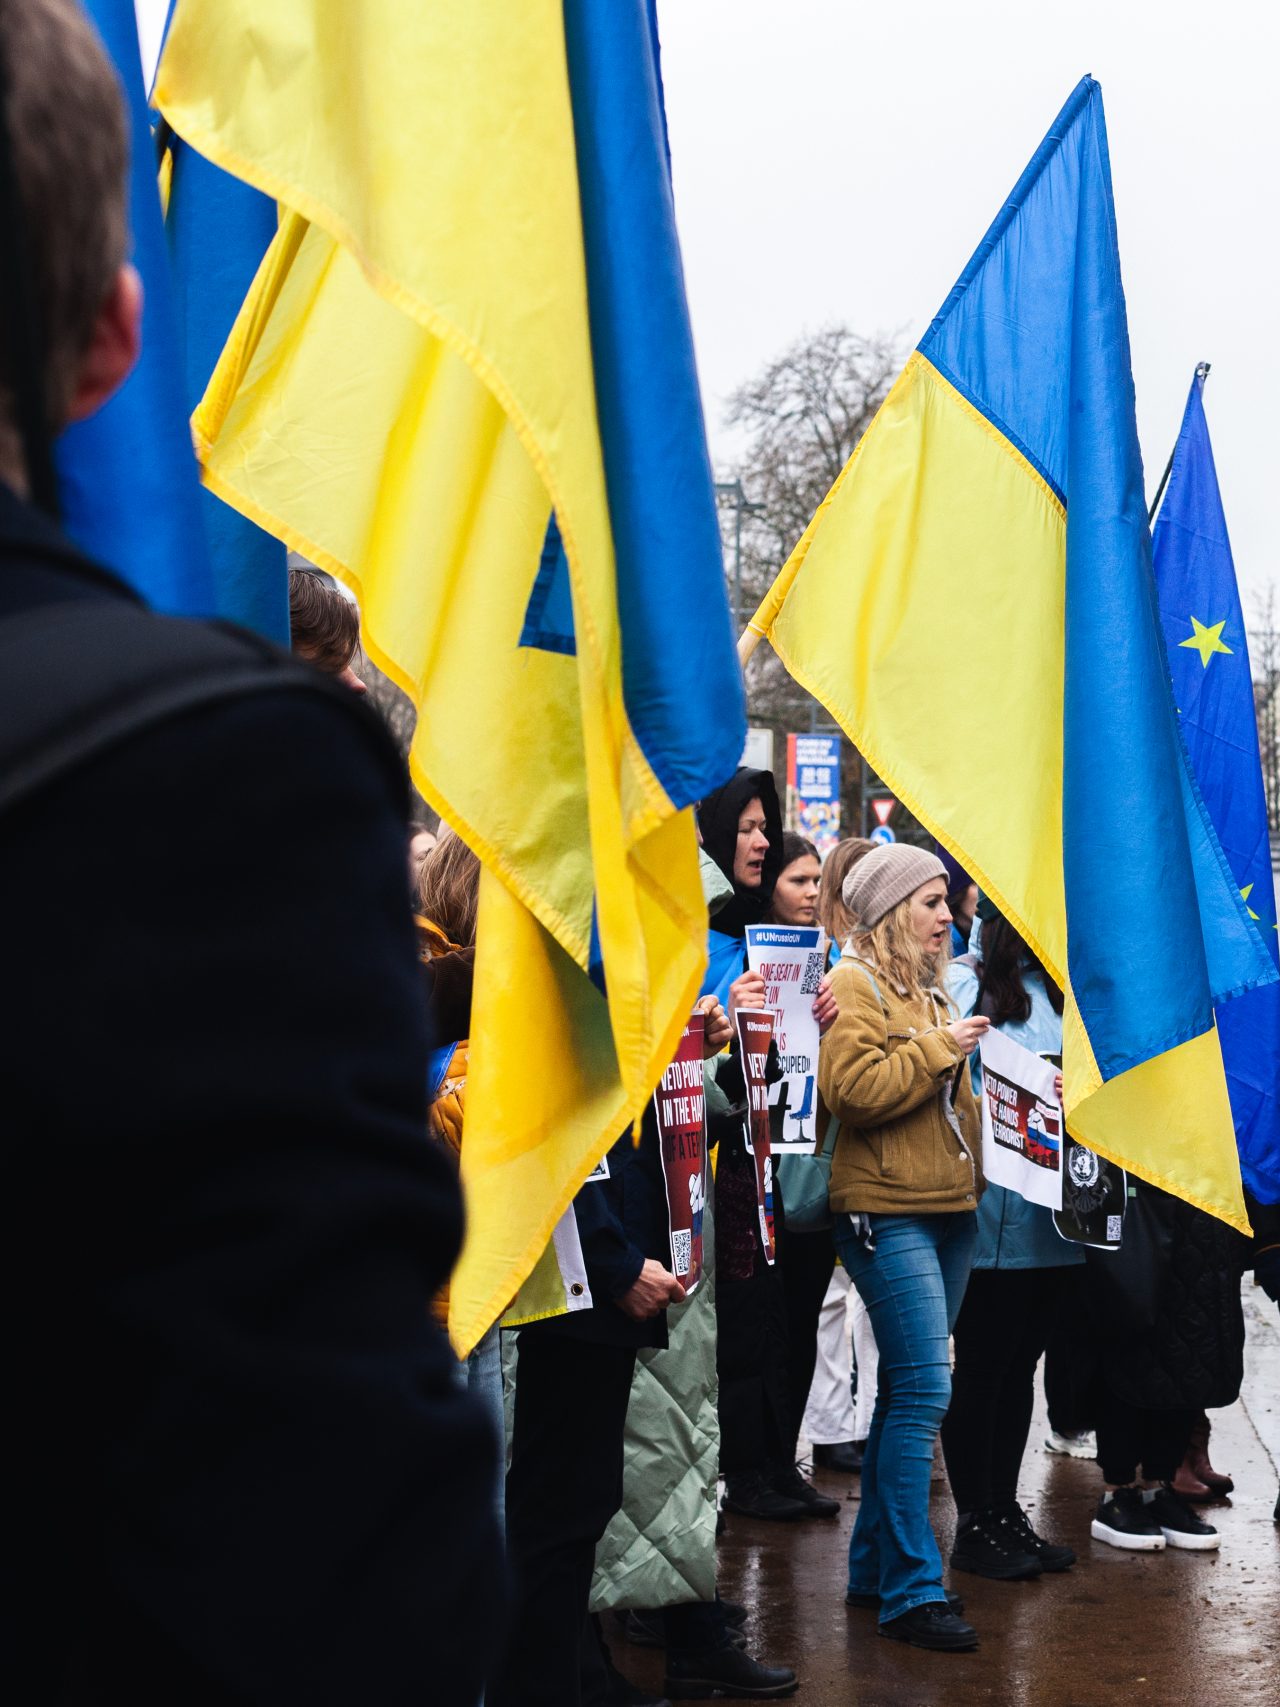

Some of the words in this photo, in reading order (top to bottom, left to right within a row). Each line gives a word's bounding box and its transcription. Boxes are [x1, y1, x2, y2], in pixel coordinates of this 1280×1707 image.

[756, 931, 801, 944] #UNrussiaUN
[760, 963, 776, 982] ONE
[774, 963, 793, 982] SEAT
[791, 963, 802, 982] IN
[768, 986, 780, 1005] UN
[996, 1081, 1018, 1107] POWER
[662, 1098, 674, 1127] IN
[673, 1096, 690, 1126] THE
[998, 1102, 1020, 1129] HANDS
[678, 1133, 686, 1161] A
